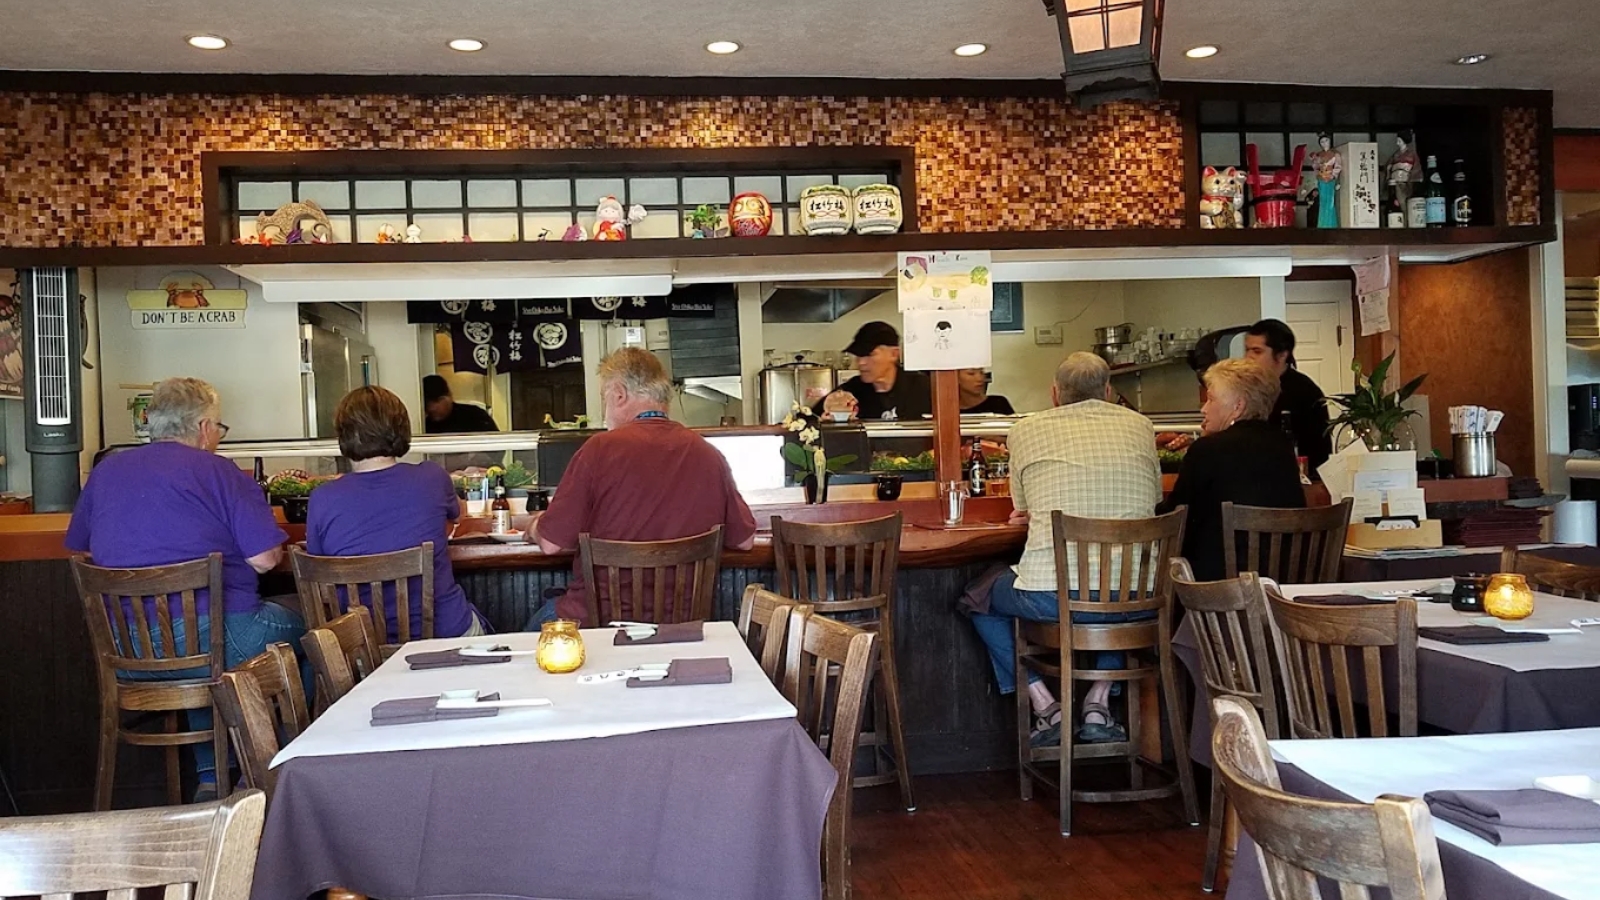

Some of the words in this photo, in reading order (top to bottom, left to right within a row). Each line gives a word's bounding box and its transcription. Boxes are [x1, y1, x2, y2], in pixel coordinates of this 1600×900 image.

[141, 311, 177, 324] DON'T
[180, 311, 194, 323] BE
[198, 311, 205, 323] A
[206, 311, 236, 323] CRAB
